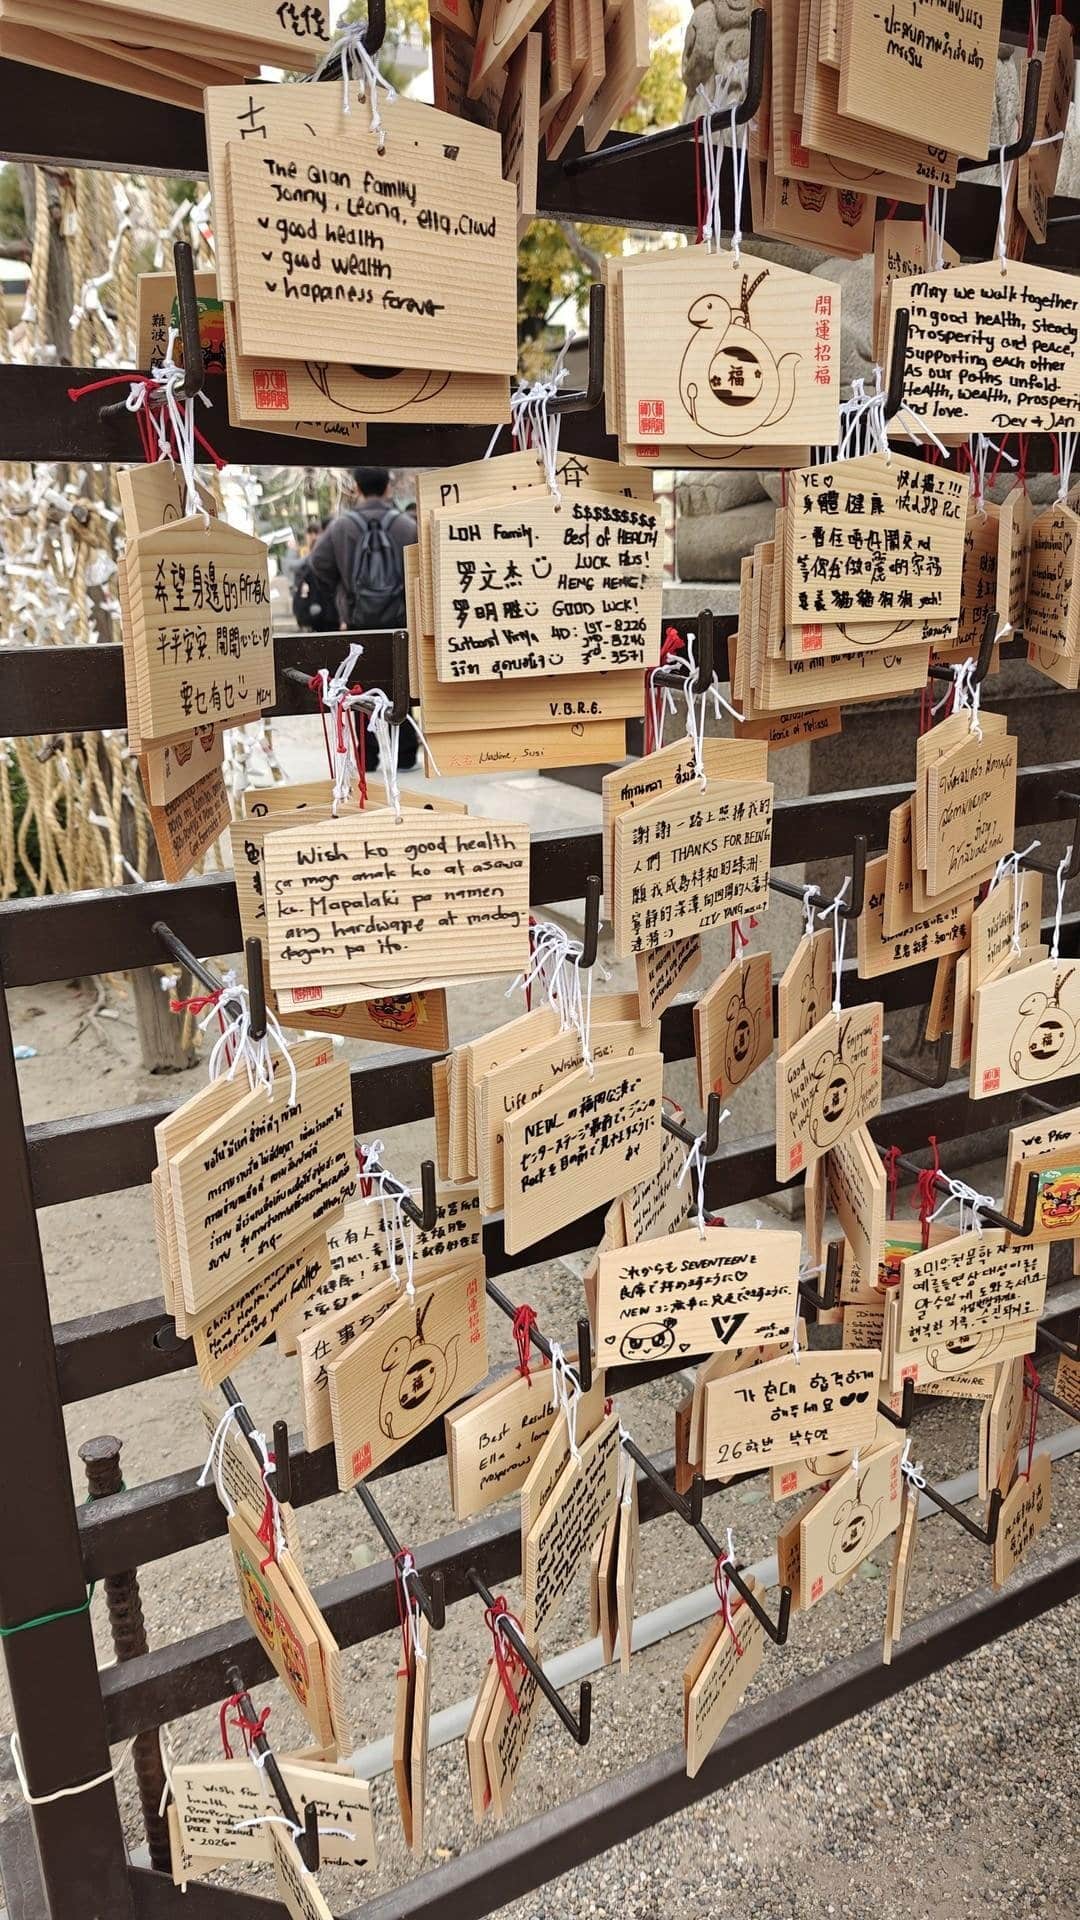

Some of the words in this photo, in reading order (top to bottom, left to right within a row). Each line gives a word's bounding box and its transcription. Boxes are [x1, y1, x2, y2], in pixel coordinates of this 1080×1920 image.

[263, 158, 297, 179] The
[276, 218, 317, 245] good
[325, 223, 385, 251] health
[282, 250, 321, 276] good
[332, 254, 392, 280] wealth
[911, 282, 947, 303] May
[954, 288, 975, 300] we
[980, 285, 1017, 301] walk
[1020, 285, 1079, 312] together
[911, 301, 927, 316] in
[931, 310, 968, 327] good
[814, 294, 833, 386] 開運招福
[1001, 335, 1027, 351] and
[727, 364, 746, 387] 福
[1030, 355, 1066, 372] other
[928, 368, 952, 380] our
[1009, 374, 1062, 393] unfold.
[933, 400, 969, 418] love.
[563, 523, 590, 548] Best
[596, 526, 611, 547] of
[617, 527, 658, 548] HEALTH
[575, 552, 611, 570] LUCK
[552, 600, 596, 617] GOOD
[602, 597, 640, 615] LUCK!
[297, 843, 349, 866] Wish
[404, 836, 448, 862] good
[456, 831, 516, 854] health
[670, 839, 719, 865] THANKS
[723, 833, 743, 849] FOR
[744, 827, 772, 846] BEING
[411, 858, 431, 878] ko
[444, 859, 466, 877] at
[472, 858, 524, 873] asawa
[310, 889, 400, 918] Mapalaki
[438, 911, 458, 928] at
[551, 1055, 588, 1076] Wishin
[787, 1058, 807, 1084] Good
[503, 1091, 527, 1113] Life
[478, 1427, 512, 1451] Best
